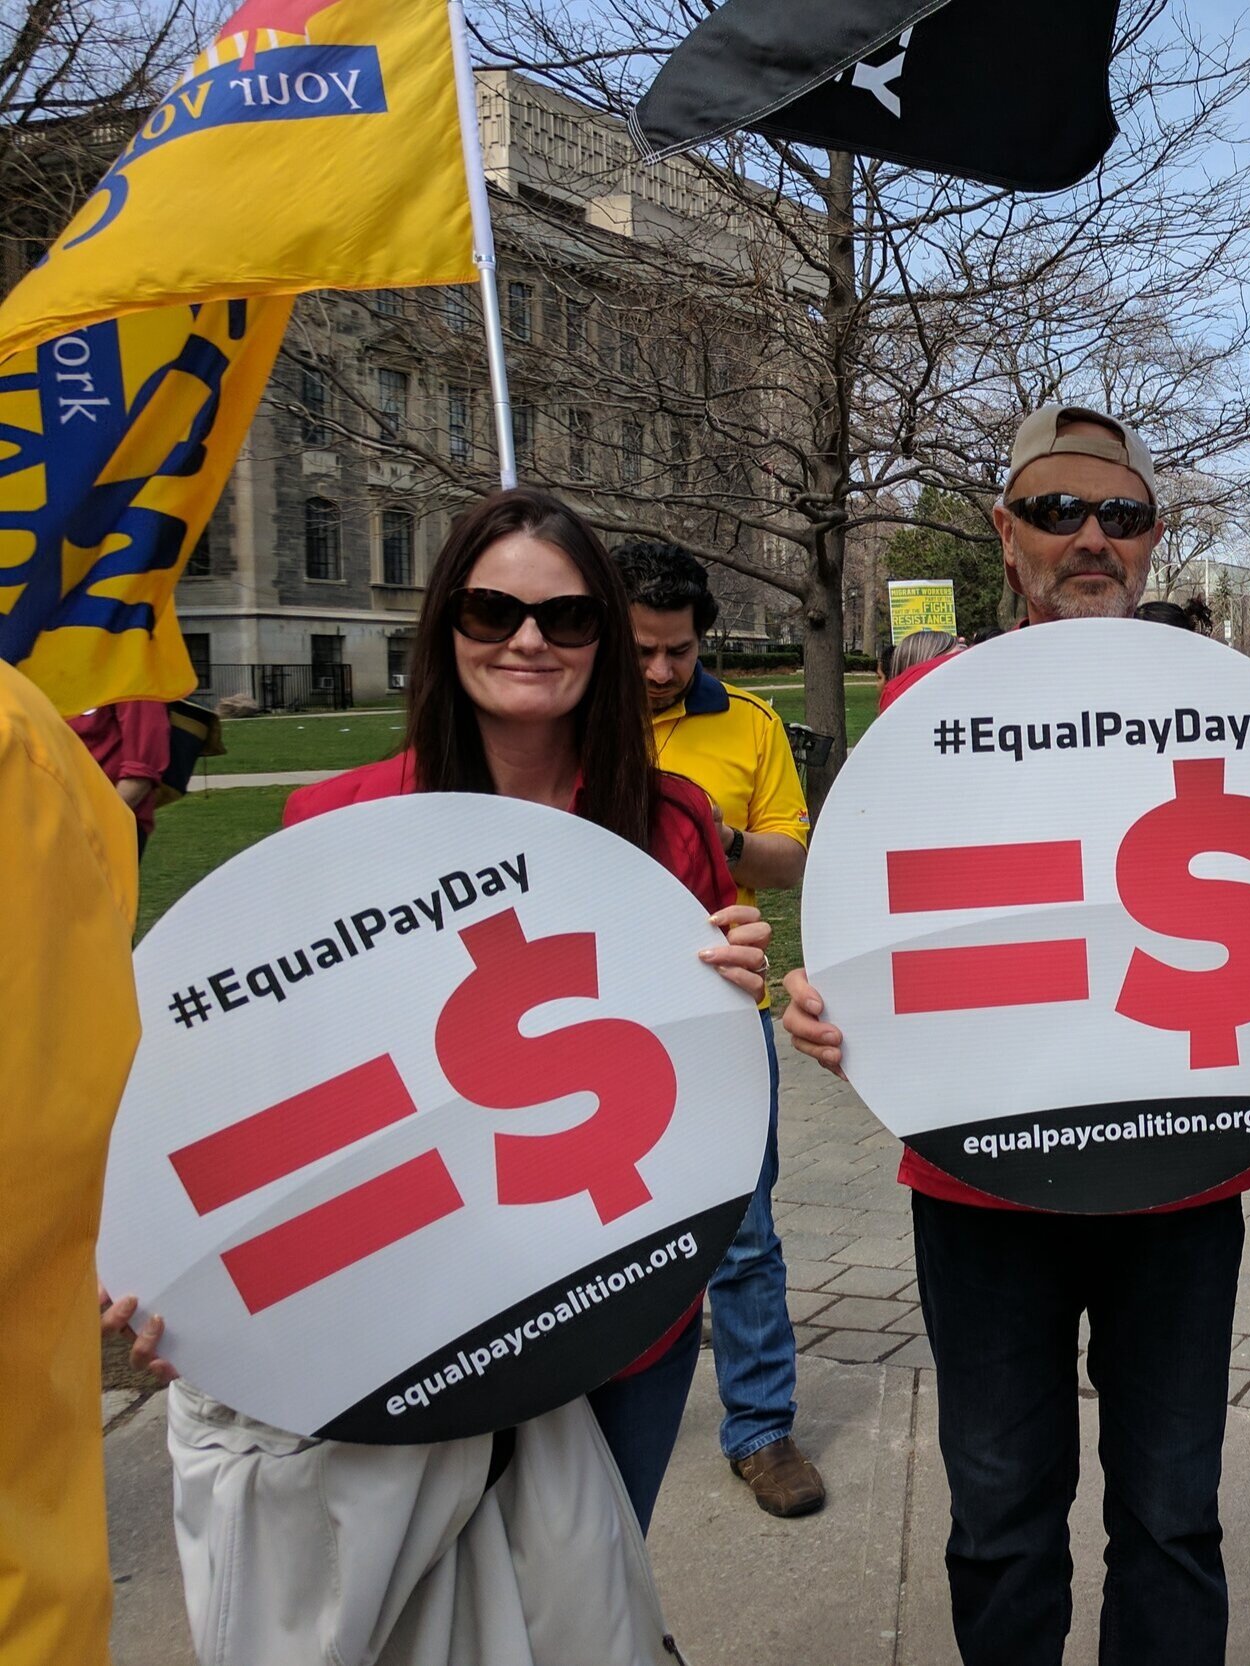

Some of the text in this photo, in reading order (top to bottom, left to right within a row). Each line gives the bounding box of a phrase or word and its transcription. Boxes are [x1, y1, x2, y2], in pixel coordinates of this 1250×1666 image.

[53, 327, 111, 425] ork
[891, 588, 920, 596] MIGRANT
[923, 602, 953, 613] FIGHT
[893, 615, 951, 625] RESISTANCE
[934, 708, 1250, 761] #EqualPayDay
[168, 853, 531, 1028] #EqualPayDay
[385, 1230, 698, 1416] equalpaycoalition.org
